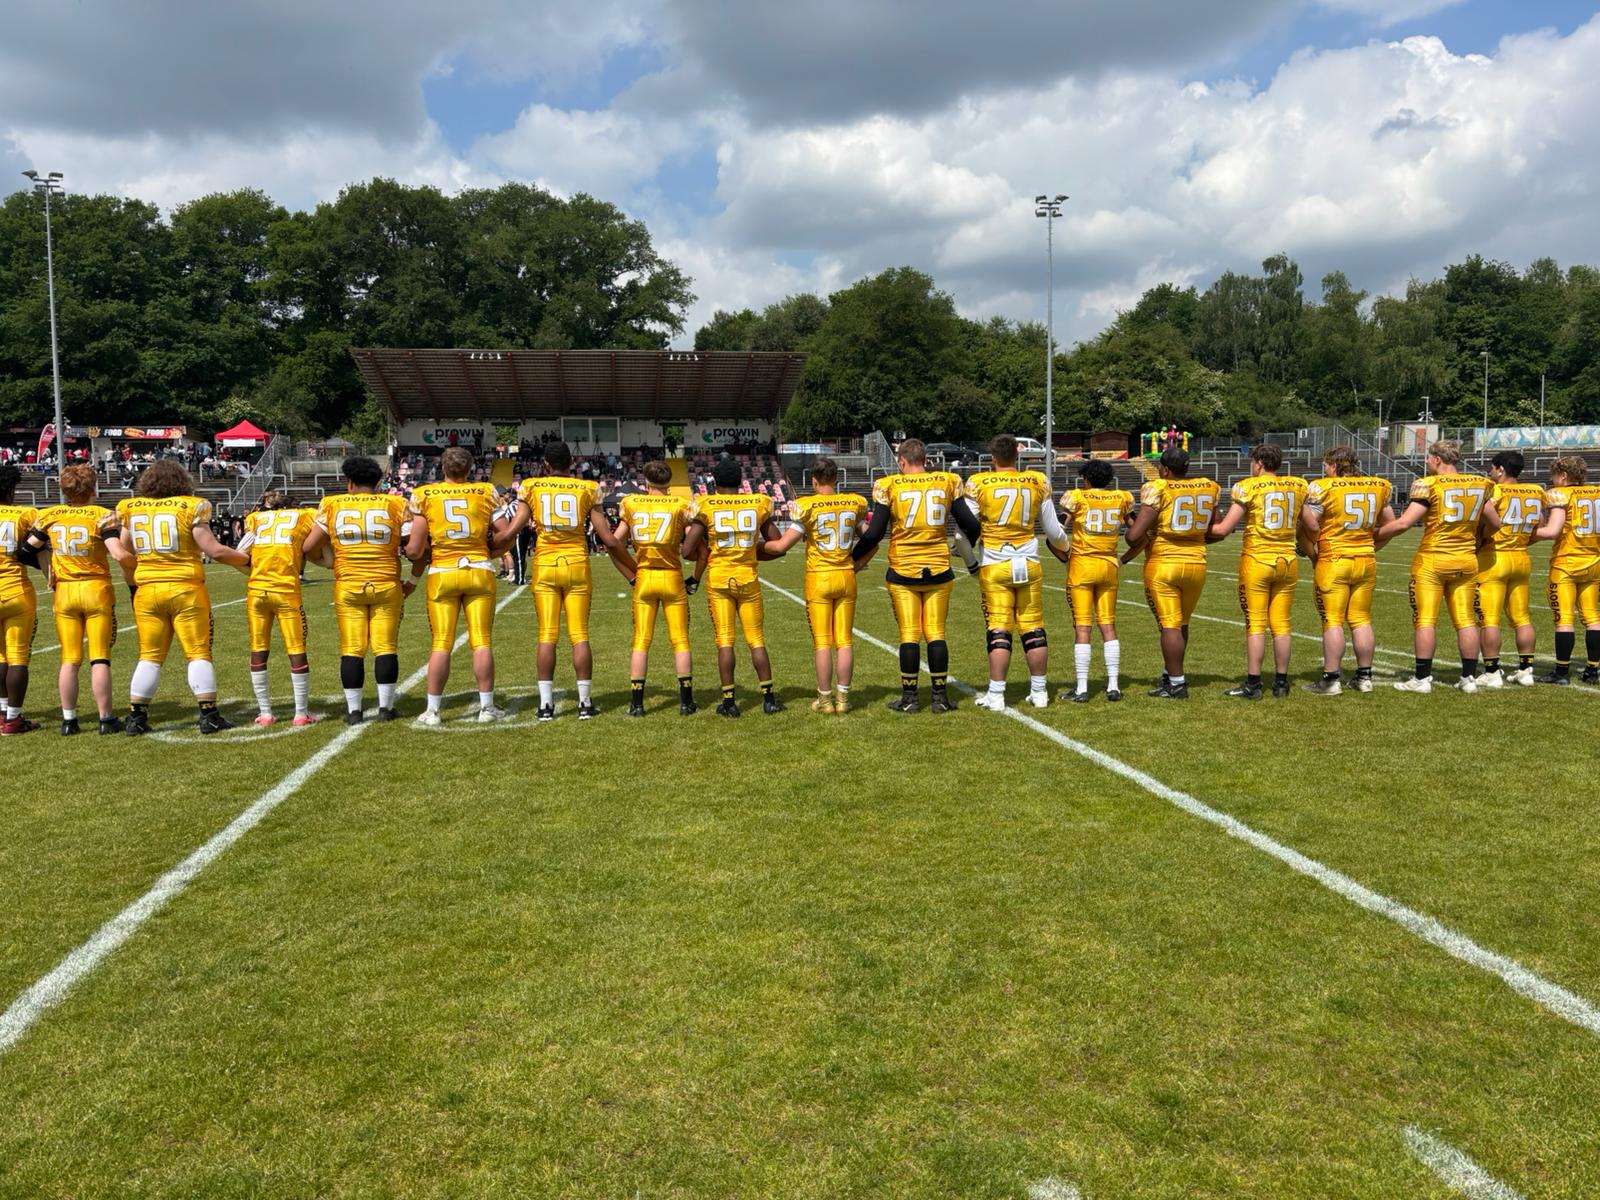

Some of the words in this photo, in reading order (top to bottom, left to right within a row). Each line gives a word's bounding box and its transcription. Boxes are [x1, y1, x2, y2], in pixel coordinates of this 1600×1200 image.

[104, 428, 122, 437] FOOD
[423, 487, 485, 496] COWBOYS
[534, 481, 587, 490] COWBOYS
[894, 475, 946, 485] COWBOYS
[982, 477, 1039, 486] COWBOYS
[1168, 481, 1212, 490] COWBOYS
[1252, 479, 1303, 488] COWBOYS
[1331, 479, 1386, 488] COWBOYS
[1501, 487, 1543, 495] COWBOYS
[50, 508, 95, 516] COWBOYS
[127, 500, 189, 510] COWBOYS
[540, 492, 579, 532] 19
[708, 497, 761, 505] COWBOYS
[811, 500, 858, 509] COWBOYS
[899, 488, 946, 529] 76
[993, 487, 1032, 527] 71
[1170, 495, 1214, 531] 65
[1263, 491, 1295, 530] 61
[1343, 492, 1377, 531] 51
[1442, 488, 1486, 523] 57
[1502, 496, 1542, 535] 42
[130, 513, 180, 555] 60
[254, 511, 300, 545] 22
[335, 509, 392, 546] 66
[444, 498, 471, 540] 5
[632, 511, 672, 543] 27
[713, 509, 757, 548] 59
[816, 511, 857, 551] 56
[1085, 508, 1122, 535] 85
[51, 524, 89, 557] 32
